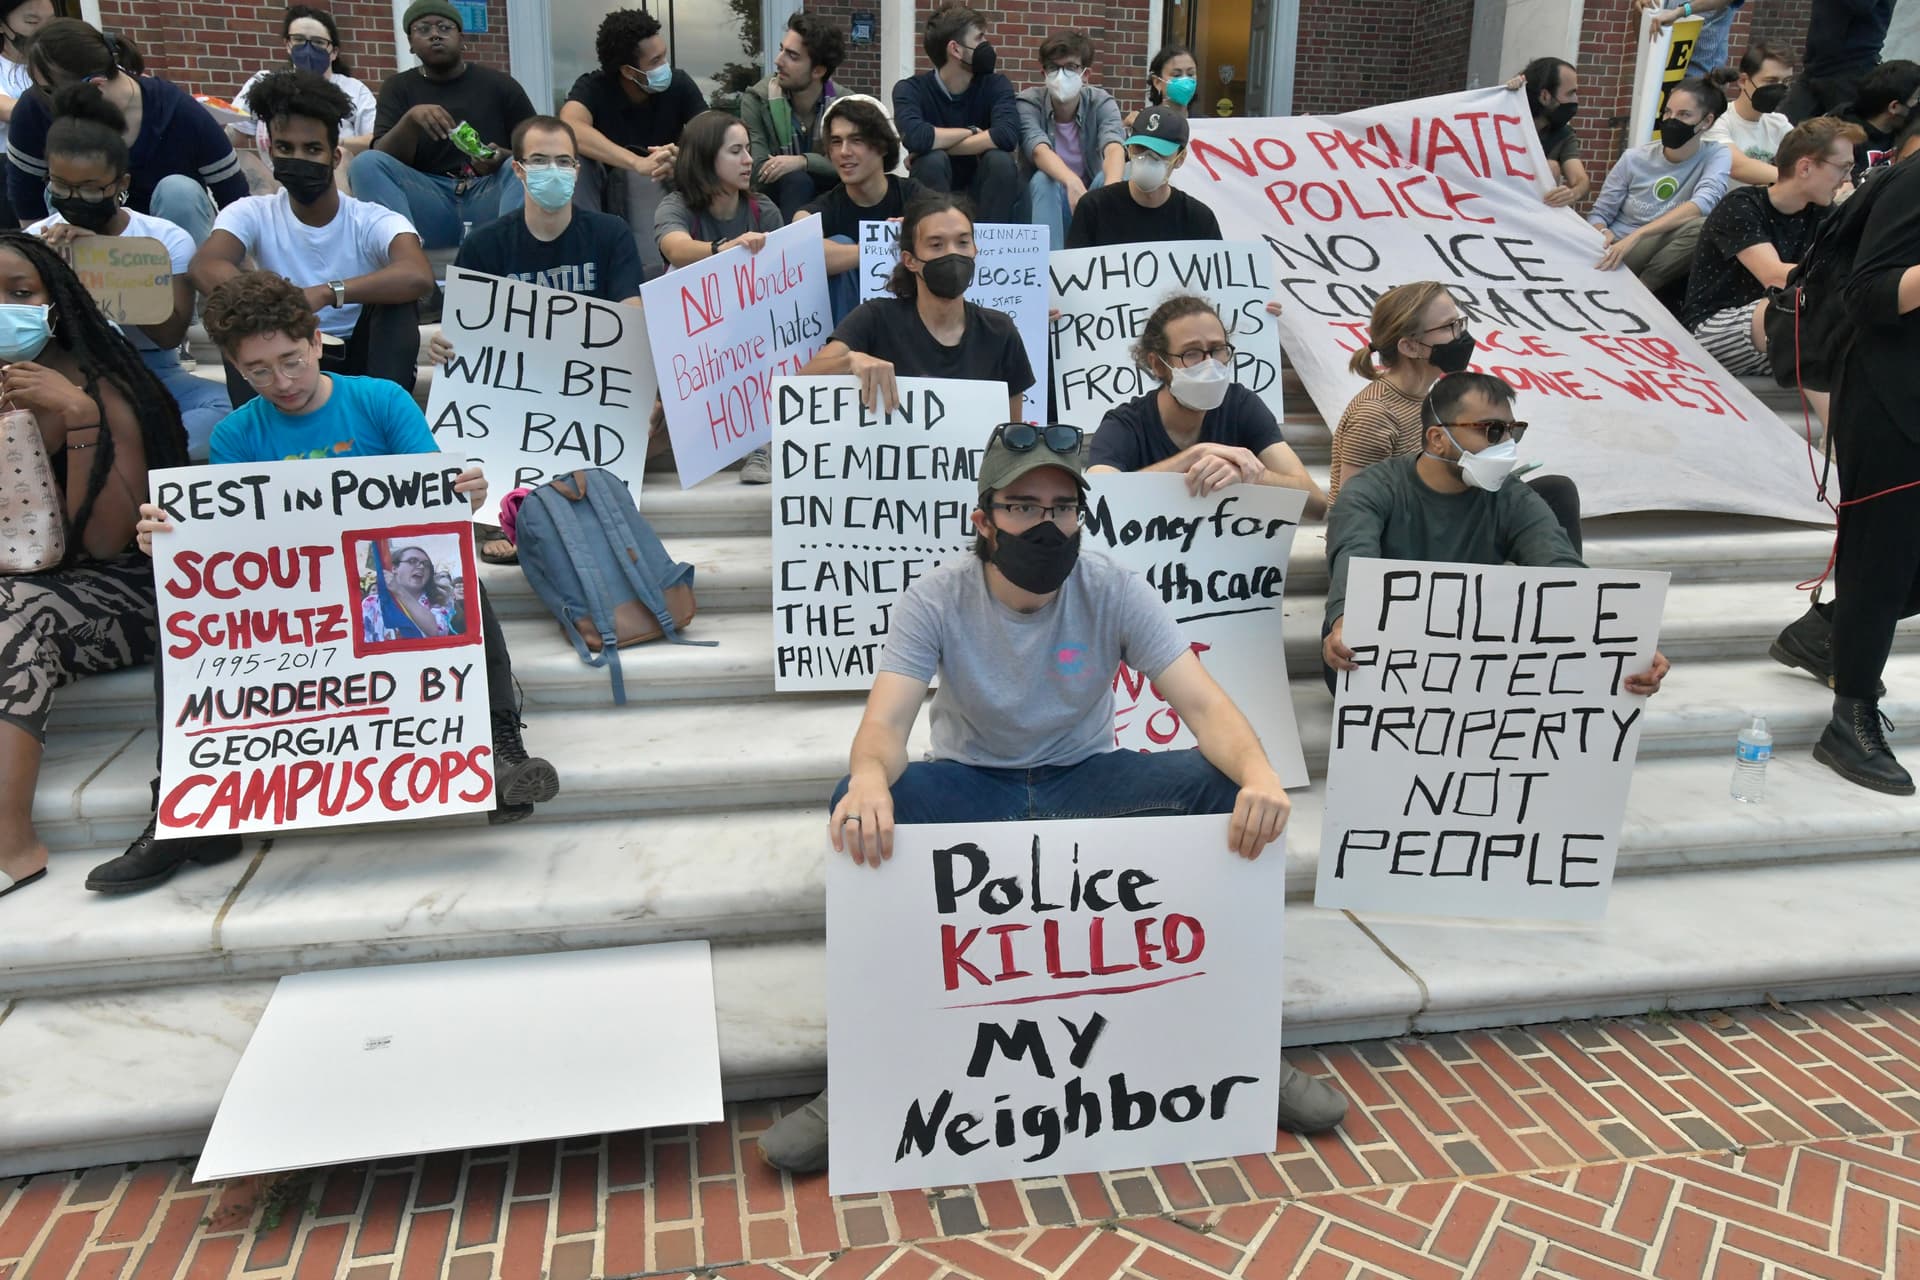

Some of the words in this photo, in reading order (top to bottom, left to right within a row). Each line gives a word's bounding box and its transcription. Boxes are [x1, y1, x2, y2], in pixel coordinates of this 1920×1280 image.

[1147, 114, 1160, 131] S
[1190, 137, 1296, 181] NO
[1264, 174, 1496, 225] POLICE
[1049, 250, 1158, 296] WHO
[1169, 250, 1269, 291] WILL
[1262, 232, 1380, 275] NO
[1424, 233, 1564, 282] ICE
[456, 273, 623, 349] JHPD
[681, 272, 724, 337] NO
[734, 249, 806, 310] Wonder
[1280, 277, 1651, 335] CORACTS
[672, 335, 764, 400] Baltimore
[770, 300, 822, 352] hates
[1051, 303, 1149, 360] PROTE
[1580, 334, 1705, 374] FOR
[444, 346, 542, 394] WILL
[559, 360, 632, 408] BE
[1585, 366, 1748, 421] WEST
[432, 401, 491, 438] AS
[520, 412, 624, 466] BAD
[778, 384, 945, 431] DEFEND
[782, 439, 984, 481] DEMOCRAC
[158, 475, 271, 522] REST
[332, 468, 468, 515] POWER
[780, 496, 832, 527] ON
[844, 497, 977, 539] CAMPU
[1082, 495, 1204, 552] Money
[1208, 497, 1297, 539] for
[165, 545, 333, 599] SCOUT
[781, 559, 941, 597] CANCE
[166, 604, 348, 660] SCHULTZ
[776, 602, 855, 636] THE
[1378, 571, 1640, 645] POLICE
[195, 647, 337, 680] 1995-2017
[778, 644, 885, 678] PRIVAT
[1344, 645, 1637, 696] PROTECT
[176, 670, 397, 728] MURDERED
[420, 663, 473, 703] BY
[189, 723, 359, 768] GEORGIA
[369, 715, 464, 751] TECH
[1337, 705, 1640, 761] PROPERTY
[159, 756, 378, 829] CAMPUS
[379, 745, 493, 810] COPS
[1403, 768, 1549, 824] NOT
[1335, 830, 1604, 888] PEOPLE
[940, 913, 1206, 991] KILLED
[966, 1012, 1108, 1078] MY
[895, 1073, 1259, 1163] Neighbor
